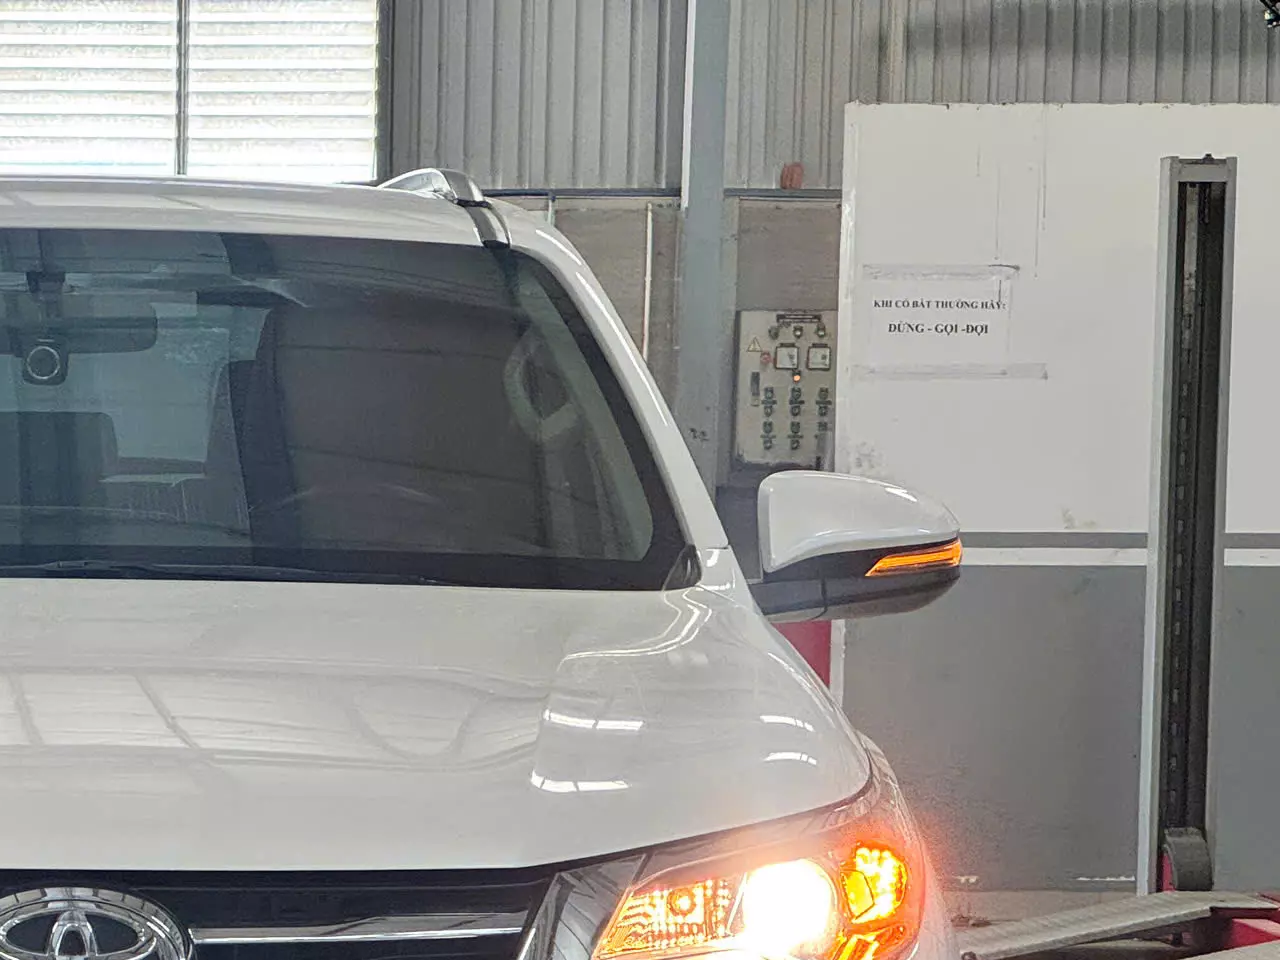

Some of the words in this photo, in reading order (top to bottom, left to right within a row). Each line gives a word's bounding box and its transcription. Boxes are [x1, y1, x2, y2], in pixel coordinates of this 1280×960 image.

[874, 299, 892, 308] KHI
[895, 297, 910, 308] CÓ
[934, 323, 958, 336] GỌI
